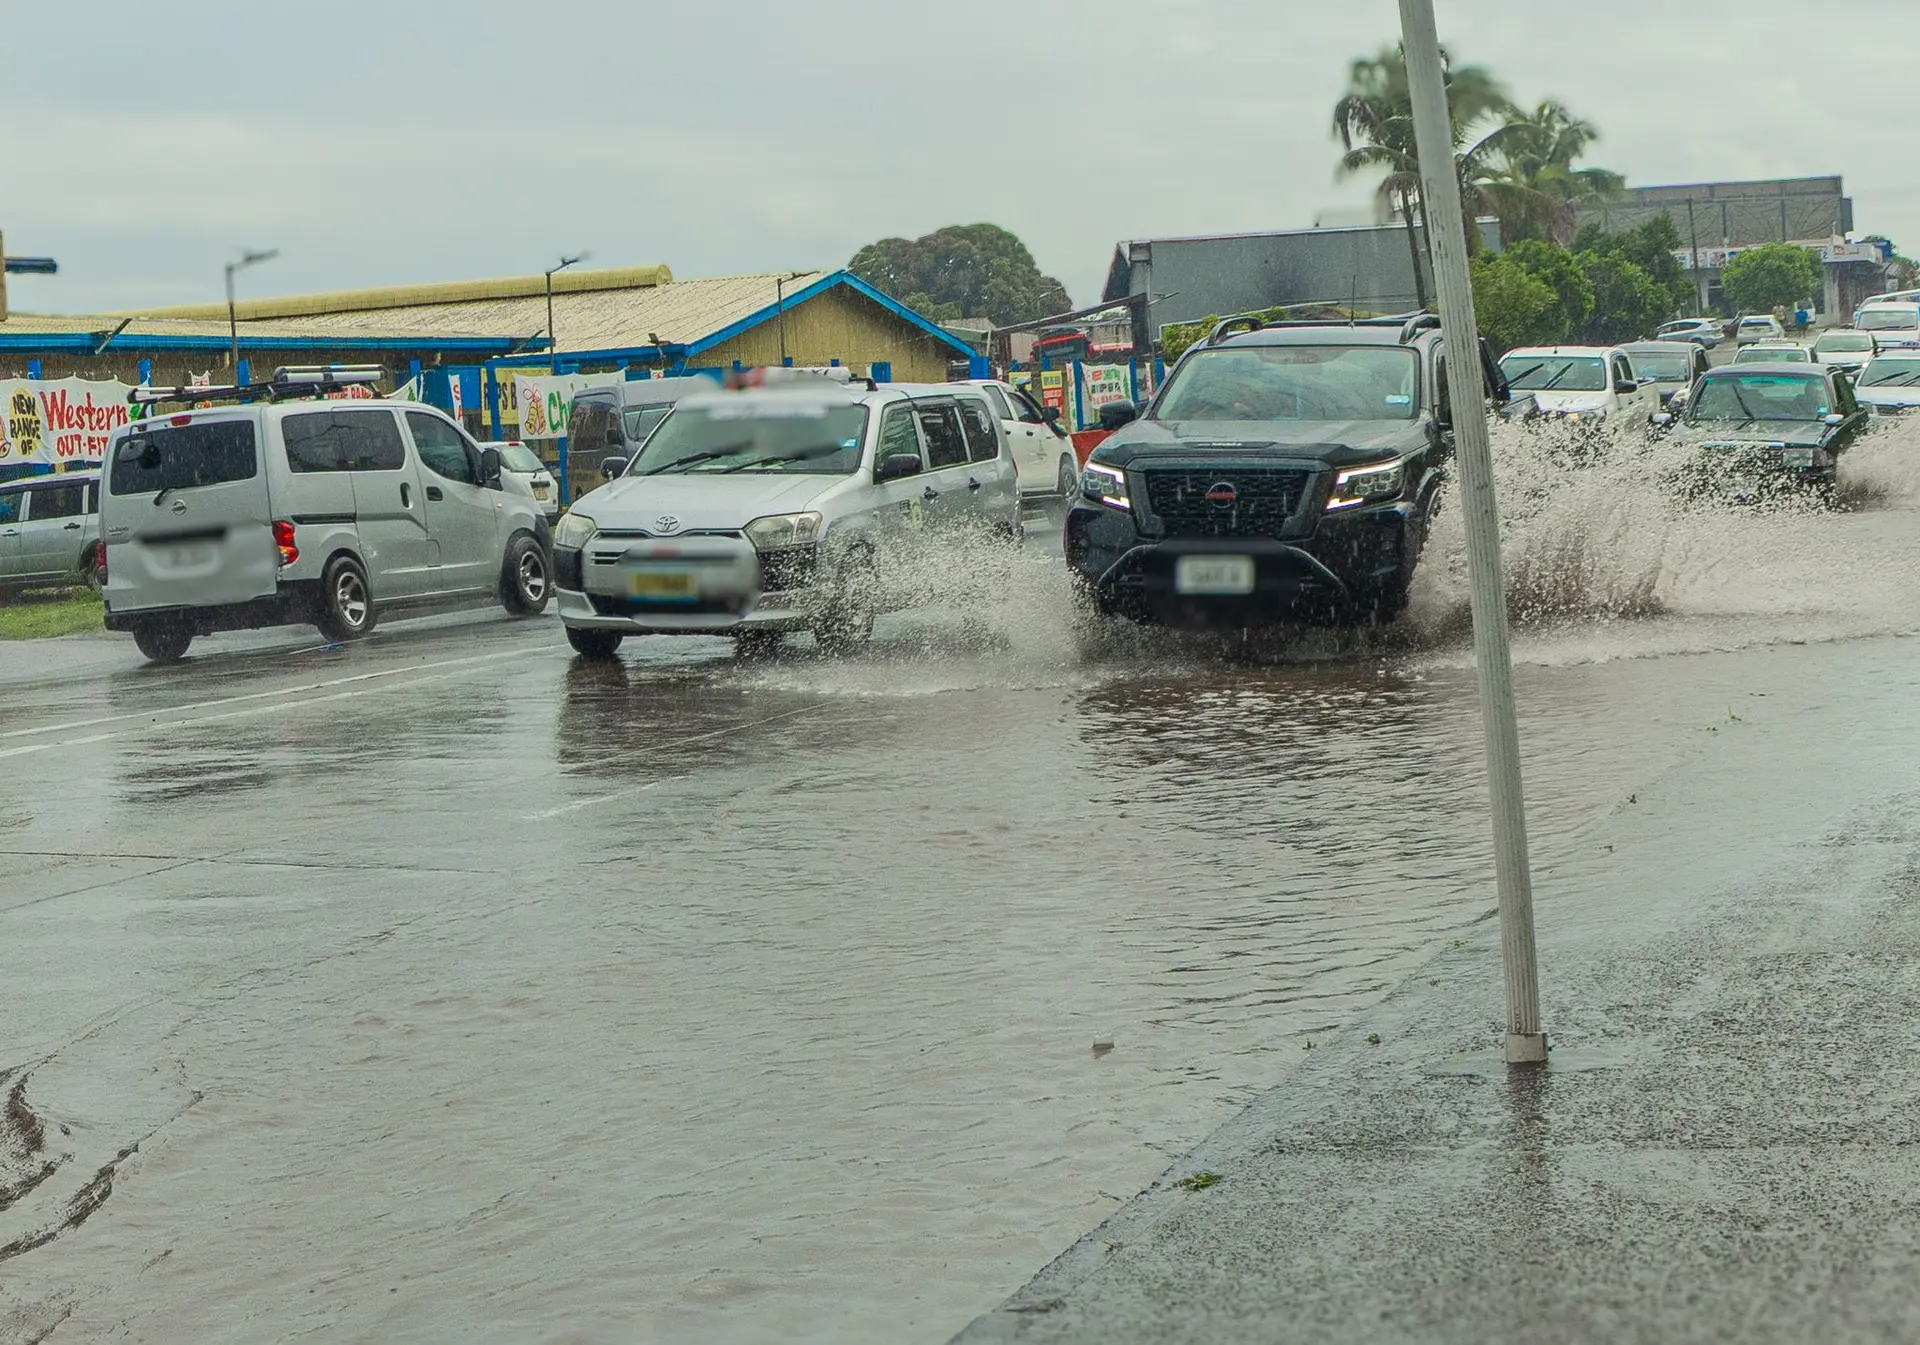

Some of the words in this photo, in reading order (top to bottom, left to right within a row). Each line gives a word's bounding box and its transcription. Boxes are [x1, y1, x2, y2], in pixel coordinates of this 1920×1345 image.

[12, 393, 36, 417] NEW
[39, 388, 128, 432] Western
[9, 418, 41, 440] RANGE
[20, 439, 33, 456] OF
